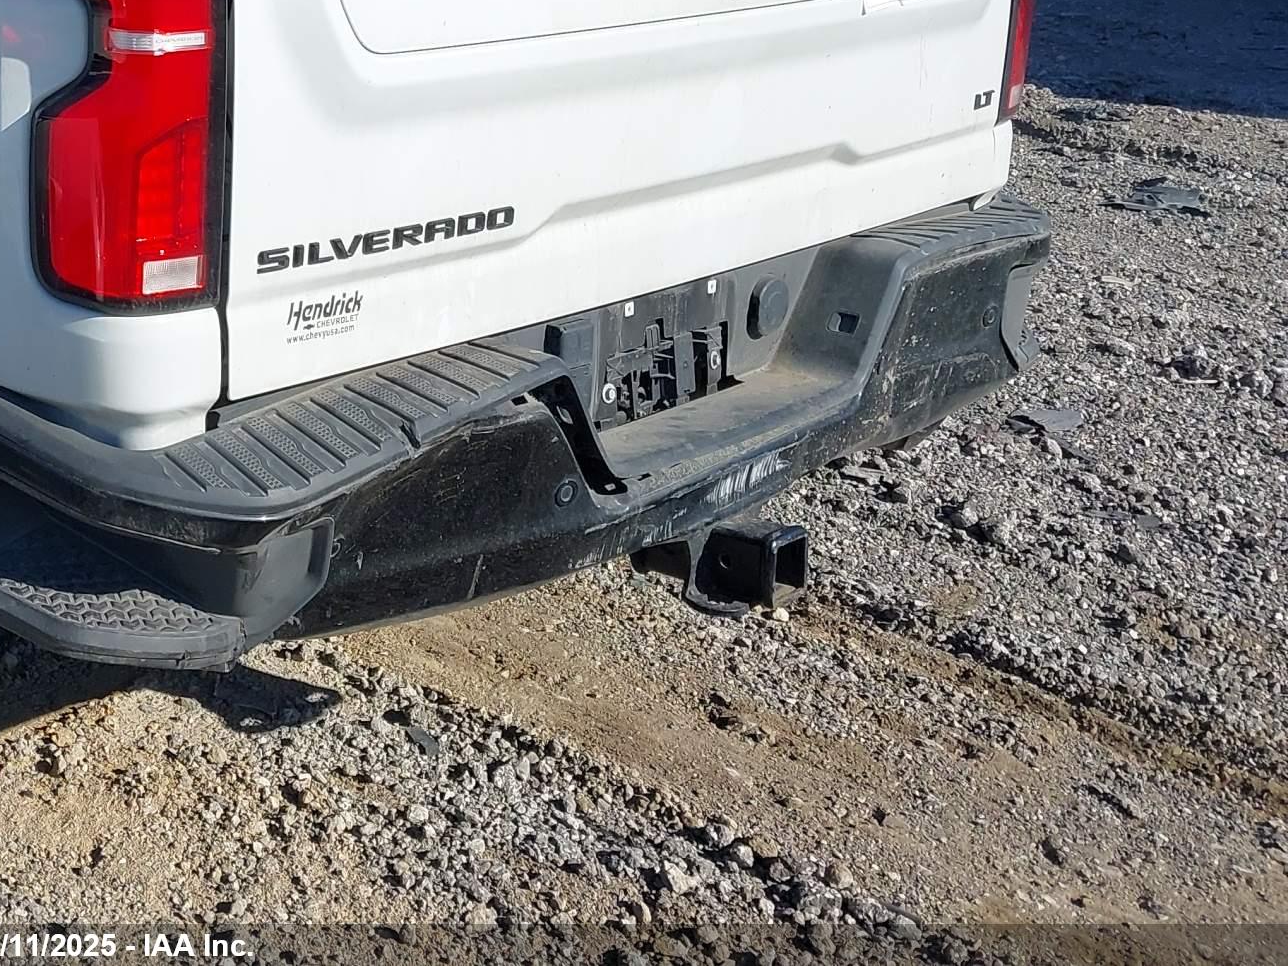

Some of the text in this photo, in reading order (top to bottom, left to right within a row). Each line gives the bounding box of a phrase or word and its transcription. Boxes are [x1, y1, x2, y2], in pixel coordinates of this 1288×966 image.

[973, 89, 995, 111] LT
[256, 205, 515, 274] SILVERADO
[286, 290, 364, 331] Hendrick
[316, 313, 360, 329] CHEVROLET
